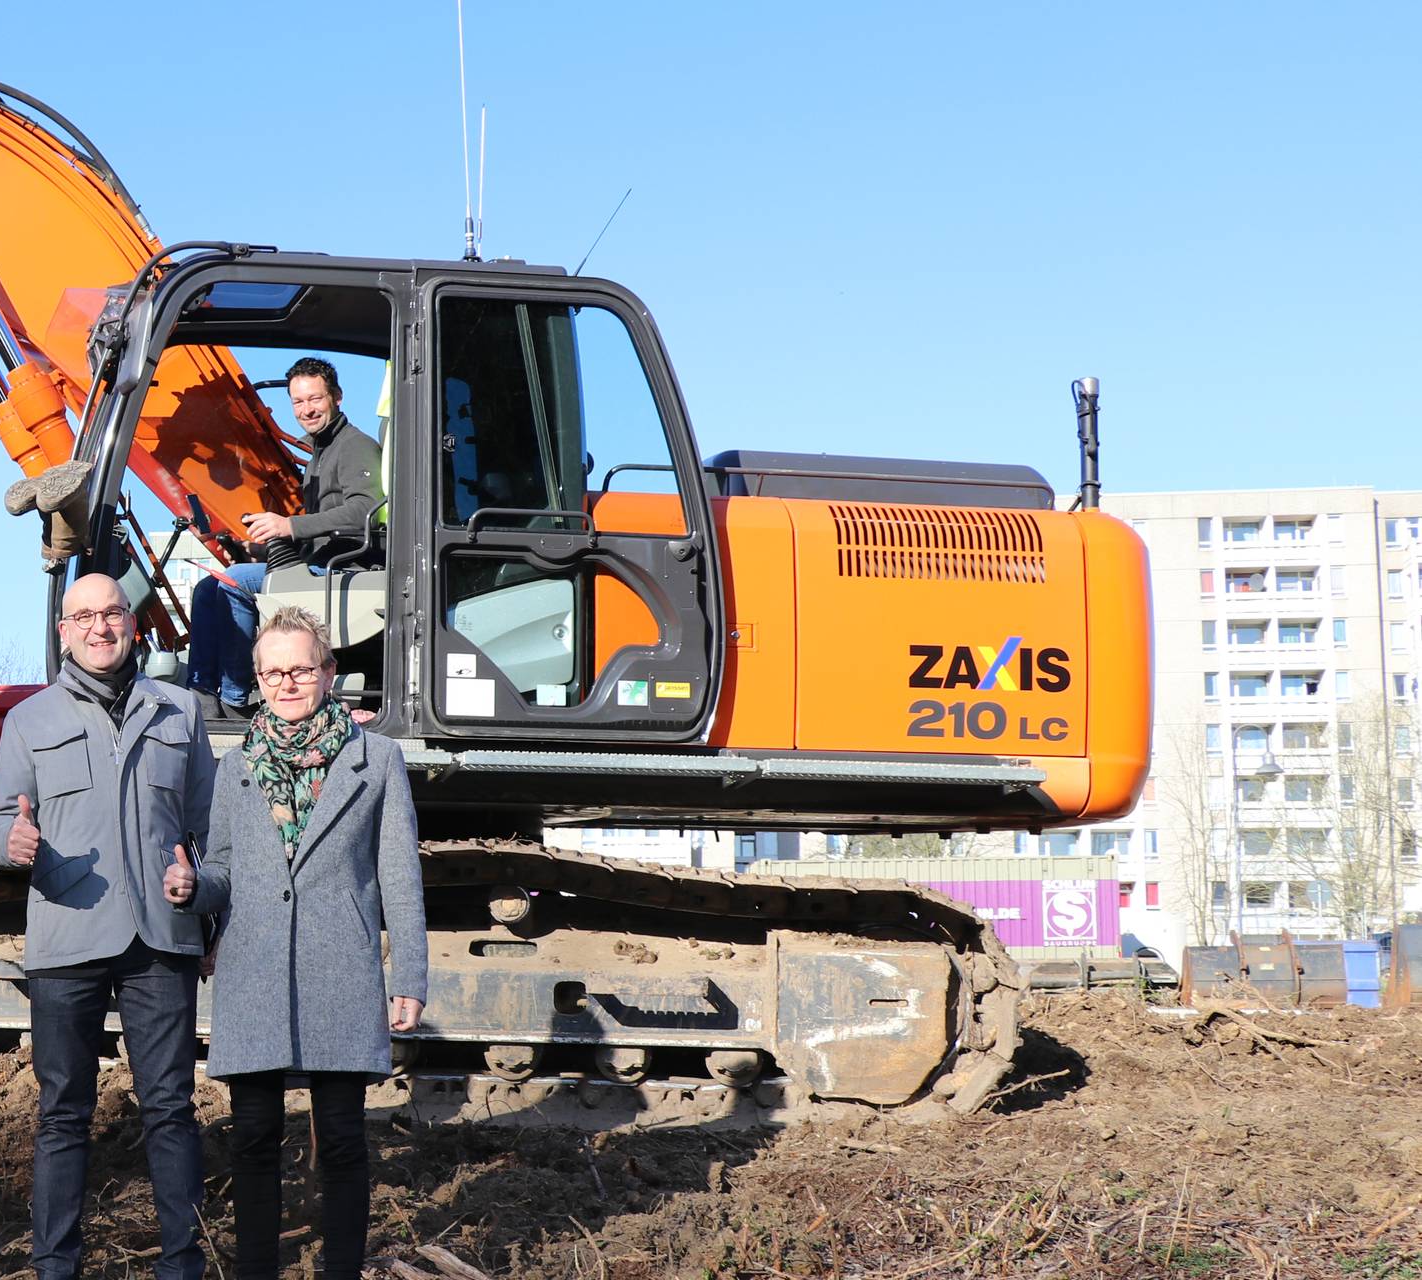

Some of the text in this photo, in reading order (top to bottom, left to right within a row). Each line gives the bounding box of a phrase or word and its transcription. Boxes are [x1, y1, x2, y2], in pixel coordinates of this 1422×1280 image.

[908, 636, 1072, 693] ZAXIS
[906, 699, 1070, 742] 210 LC
